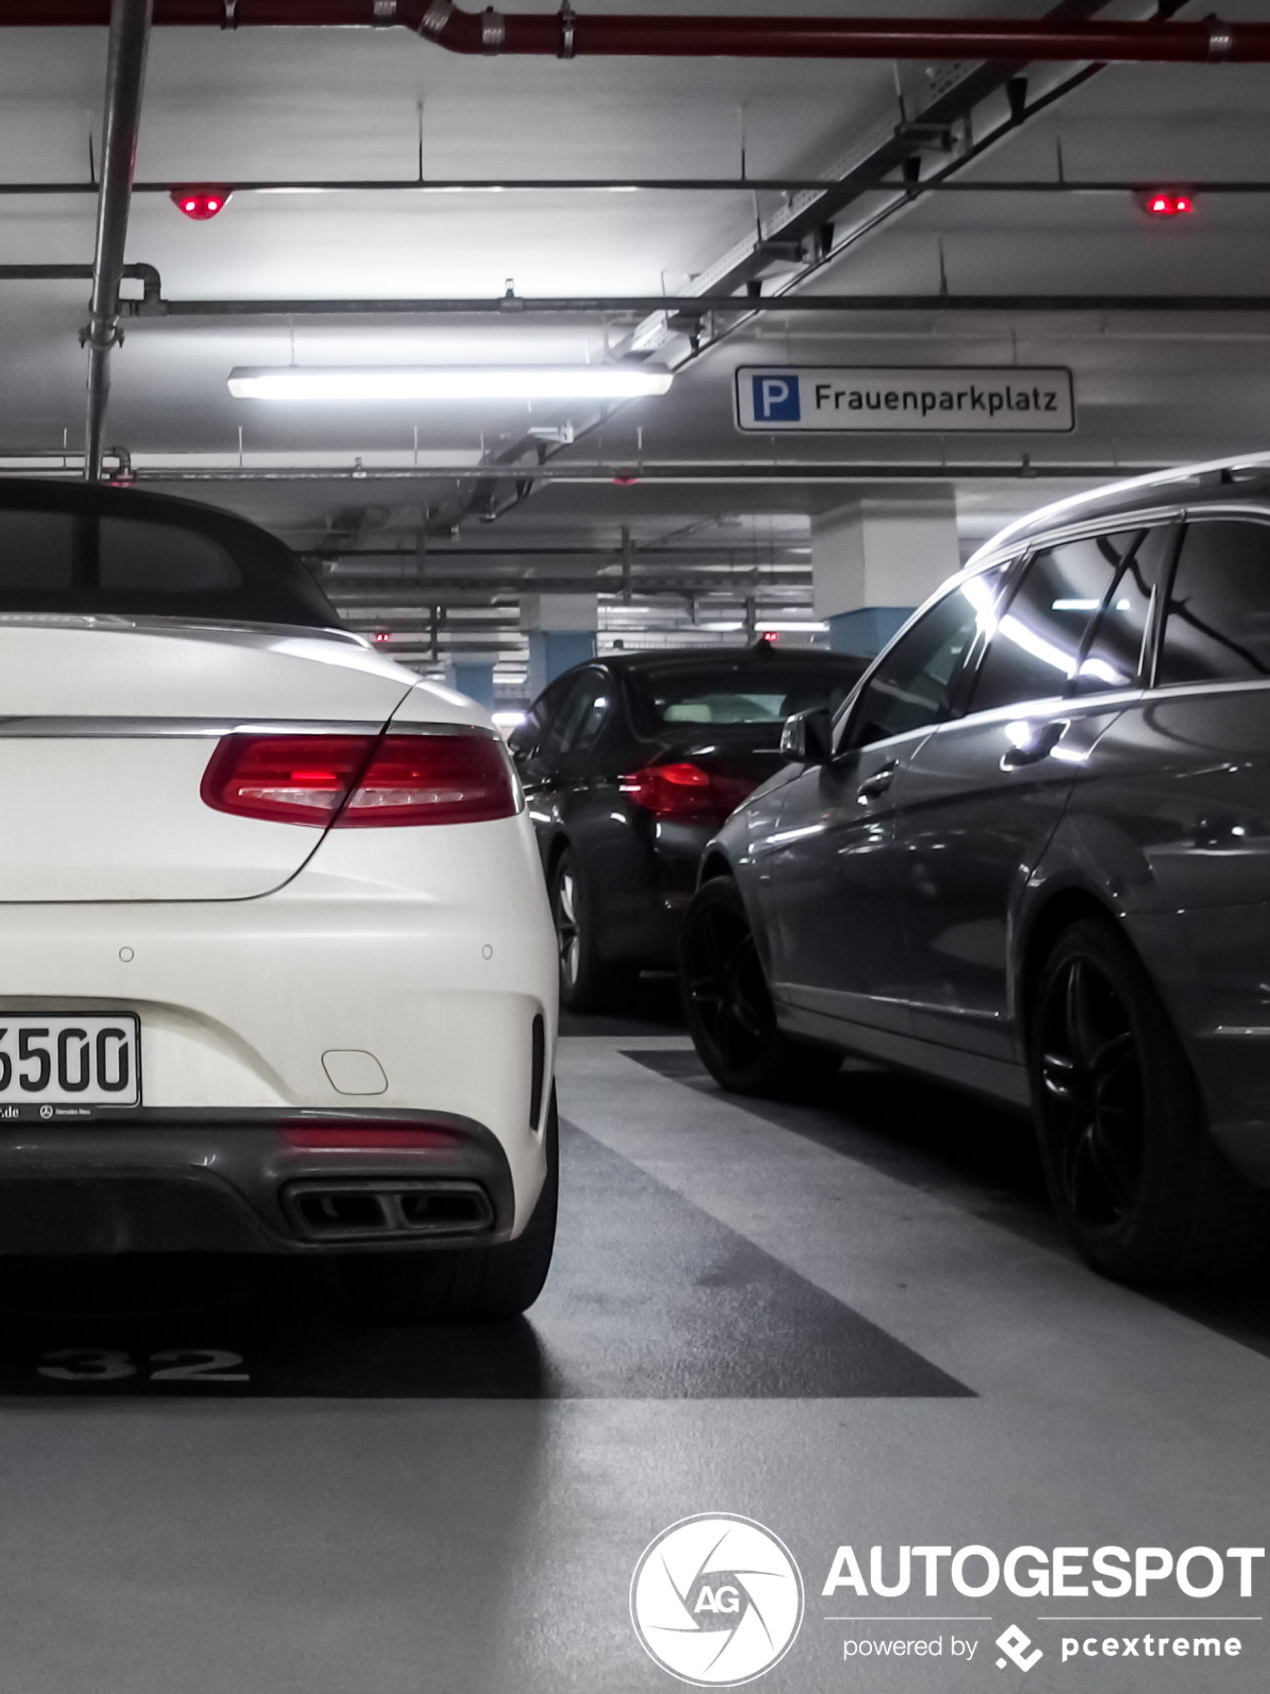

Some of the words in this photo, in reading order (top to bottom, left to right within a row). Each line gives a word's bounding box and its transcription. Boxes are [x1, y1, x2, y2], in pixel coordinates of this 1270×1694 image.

[761, 379, 789, 417] P
[815, 384, 1058, 417] Frauenparkplatz
[37, 1349, 250, 1381] 32
